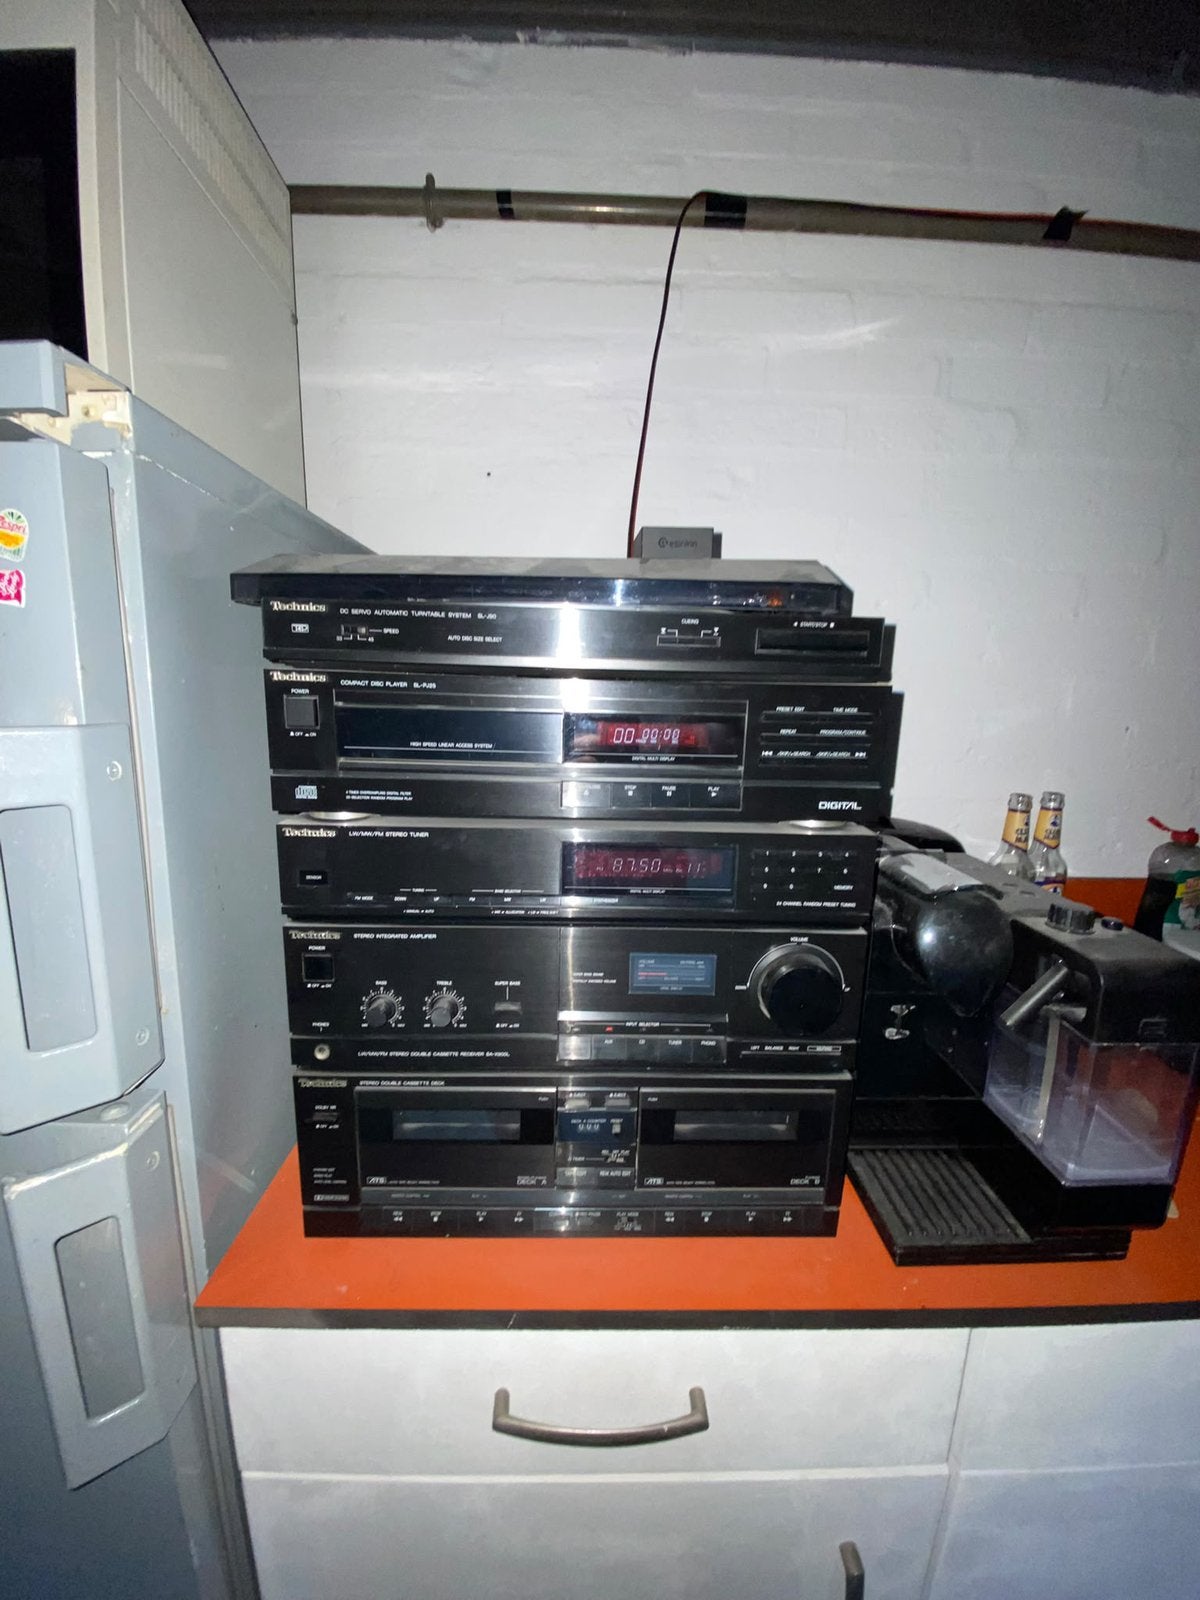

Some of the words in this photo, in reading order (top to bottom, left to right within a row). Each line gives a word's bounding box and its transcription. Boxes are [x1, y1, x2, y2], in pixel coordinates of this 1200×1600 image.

[270, 601, 326, 612] Technics
[270, 671, 326, 682] Technics
[340, 679, 369, 687] COMPACT
[613, 728, 635, 744] 00
[642, 728, 680, 740] 00:00
[818, 801, 862, 810] DIGITAL
[282, 827, 336, 838] Technics
[288, 930, 342, 940] Technics
